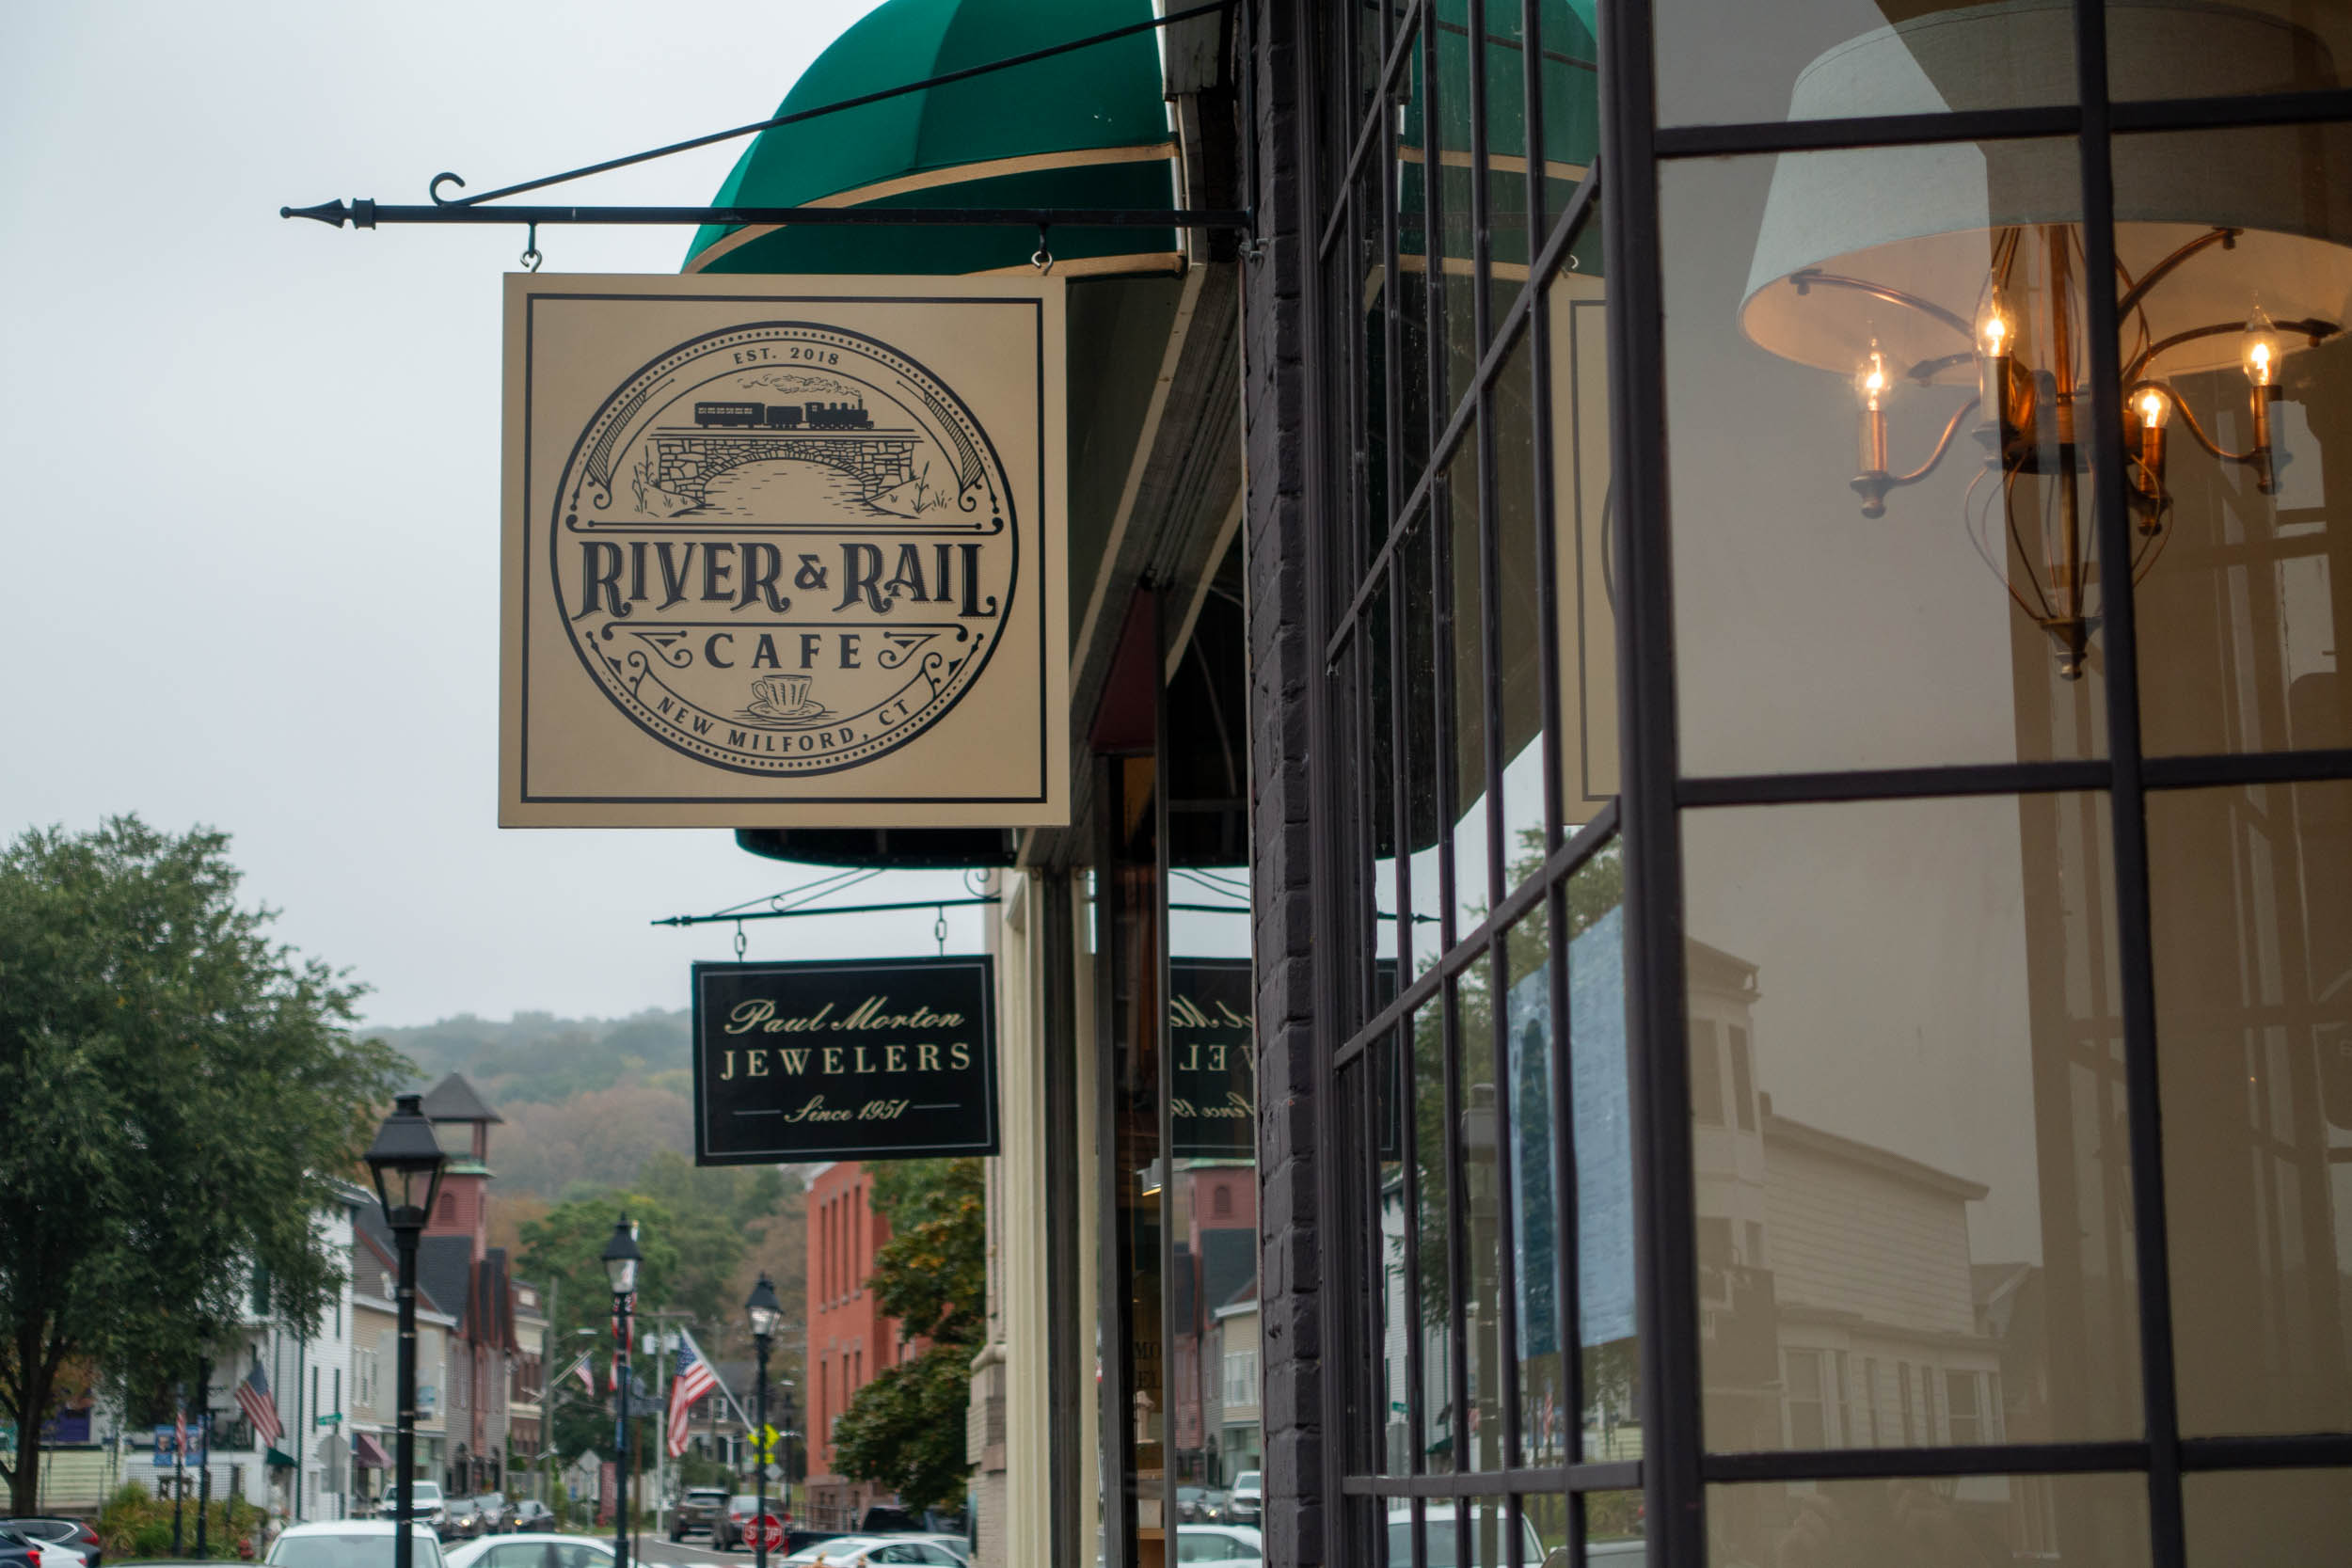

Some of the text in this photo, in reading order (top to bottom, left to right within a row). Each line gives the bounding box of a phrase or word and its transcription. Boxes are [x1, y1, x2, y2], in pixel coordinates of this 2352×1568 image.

[733, 346, 839, 366] EST. 2018
[571, 541, 998, 621] RIVER & RAIL
[705, 633, 862, 669] CAFE
[657, 696, 910, 752] NEW MILFORD, CT
[723, 995, 965, 1035] Paul Morton
[720, 1042, 971, 1081] JEWELERS
[784, 1094, 910, 1122] Since 1951
[745, 1525, 782, 1542] SOP
